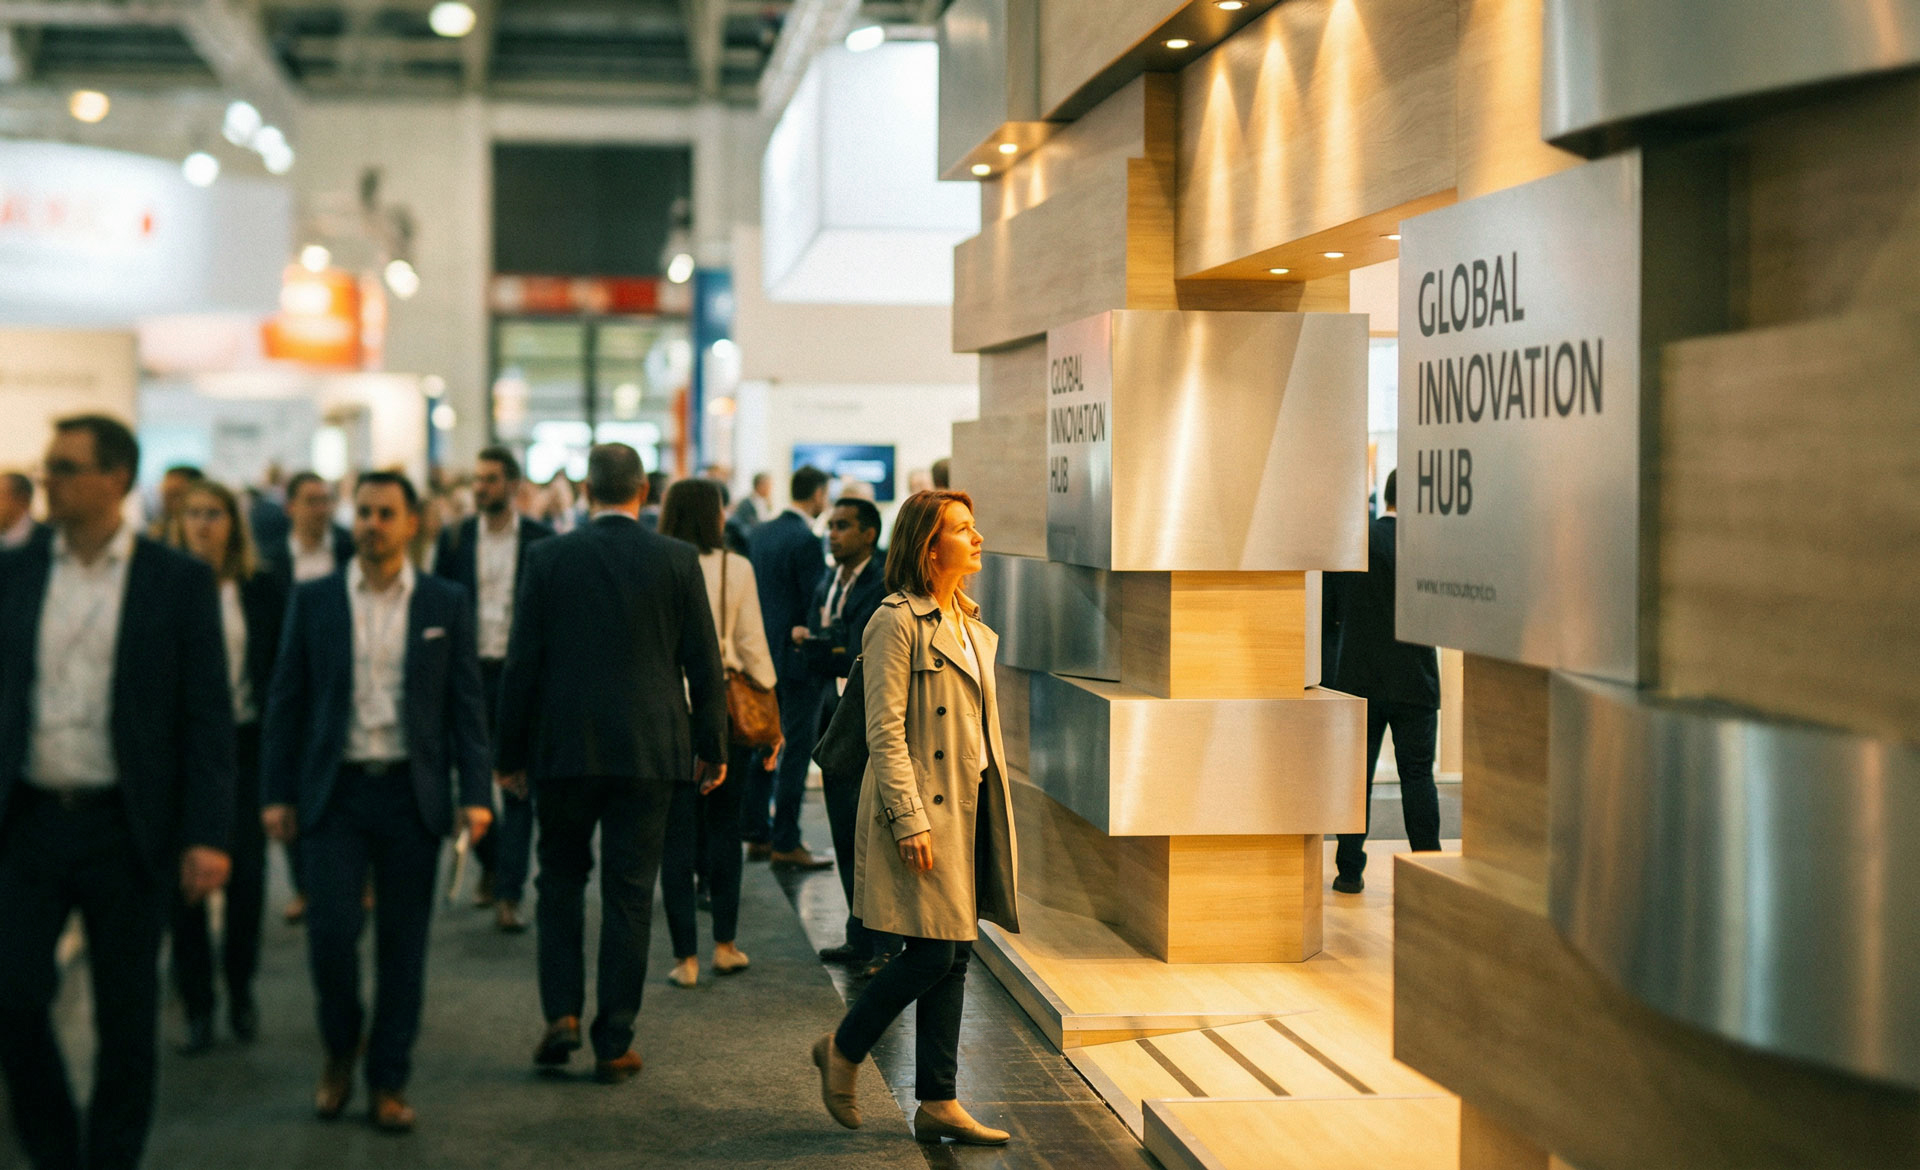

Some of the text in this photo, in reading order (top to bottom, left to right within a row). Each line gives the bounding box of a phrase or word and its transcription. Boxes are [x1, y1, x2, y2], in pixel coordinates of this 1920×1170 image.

[1418, 251, 1524, 337] GLOBAL
[1052, 354, 1083, 395] GLOBAL
[1418, 338, 1603, 426] INNOVATION
[1051, 402, 1106, 444] INNOVATION
[1051, 456, 1068, 493] HUB
[1417, 448, 1473, 516] HUB
